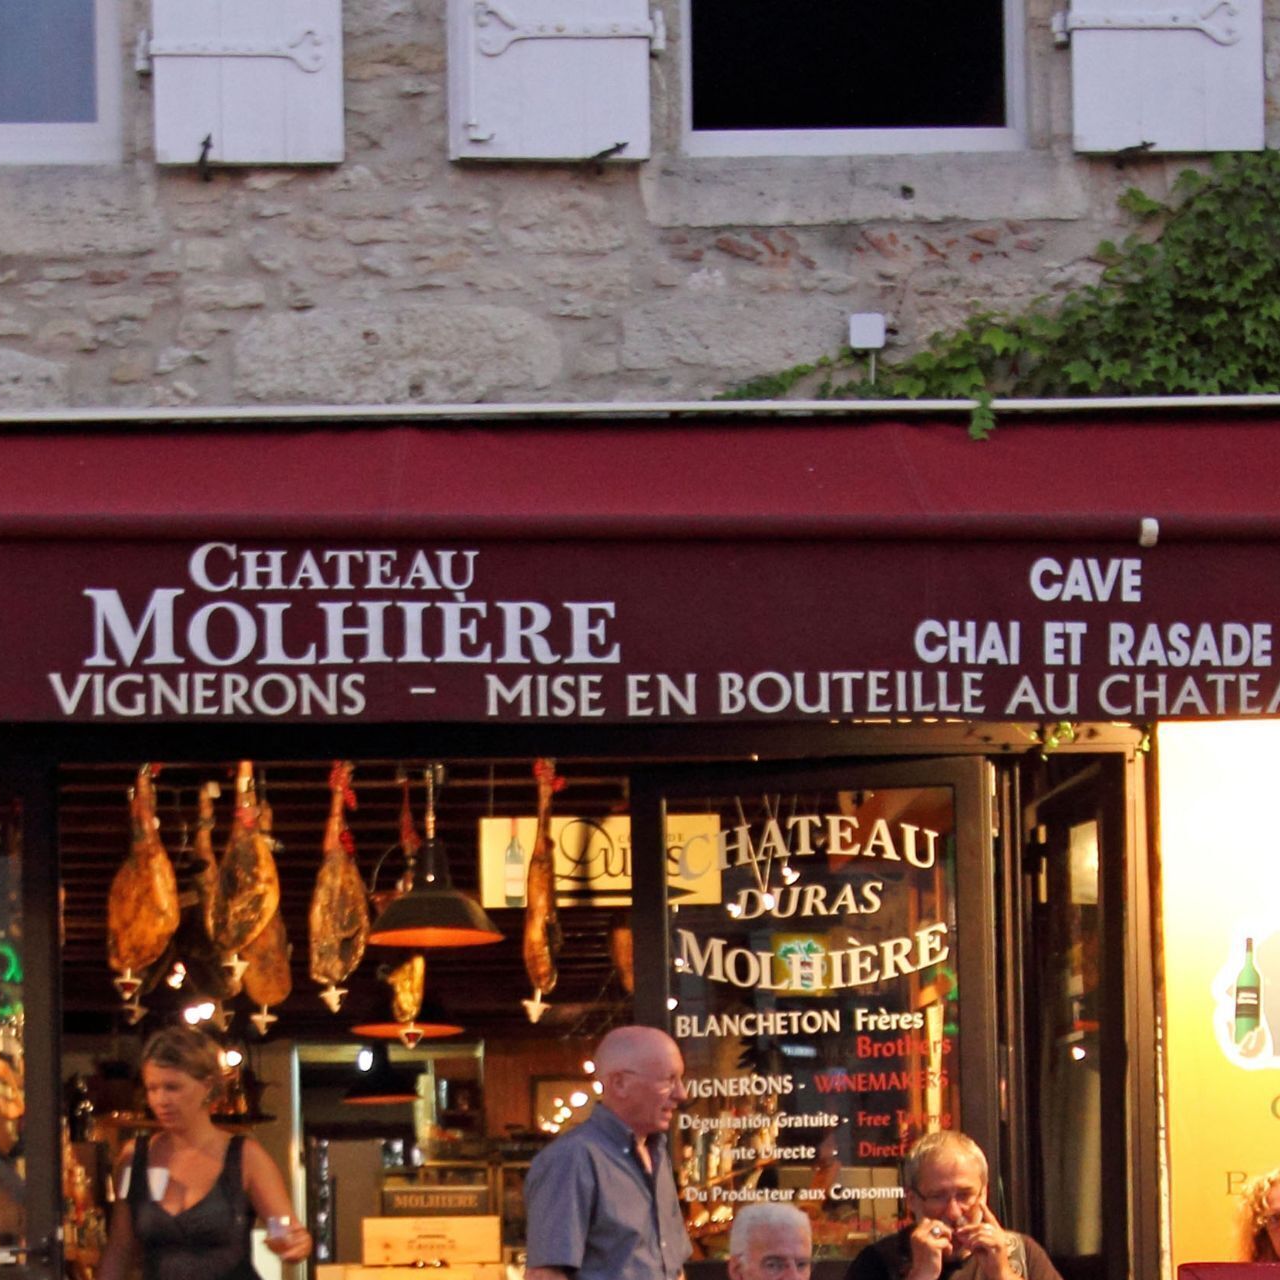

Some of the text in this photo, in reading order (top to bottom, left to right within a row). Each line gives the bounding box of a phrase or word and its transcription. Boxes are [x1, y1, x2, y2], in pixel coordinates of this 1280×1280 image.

[188, 541, 479, 592] CHATEAU
[1029, 557, 1142, 603] CAVE
[82, 587, 622, 668] MOLHIÈRE
[913, 618, 1273, 669] CHAI ET RASADE
[48, 672, 367, 717] VIGNERONS
[484, 673, 606, 717] MISE
[626, 672, 698, 717] EN
[720, 670, 985, 715] BOUTEILLE
[1004, 672, 1078, 715] AU
[678, 813, 940, 882] CHATEAU
[736, 880, 884, 920] DURAS
[677, 921, 951, 992] MOLHIÈRE
[675, 1007, 925, 1039] BLANCHETON Frères
[678, 1112, 771, 1134] Dégustation
[774, 1110, 840, 1129] Gratuite
[857, 1110, 890, 1127] Free
[760, 1145, 816, 1160] Directe
[684, 1186, 708, 1203] Du
[711, 1184, 796, 1203] Producteur
[798, 1187, 826, 1201] aux
